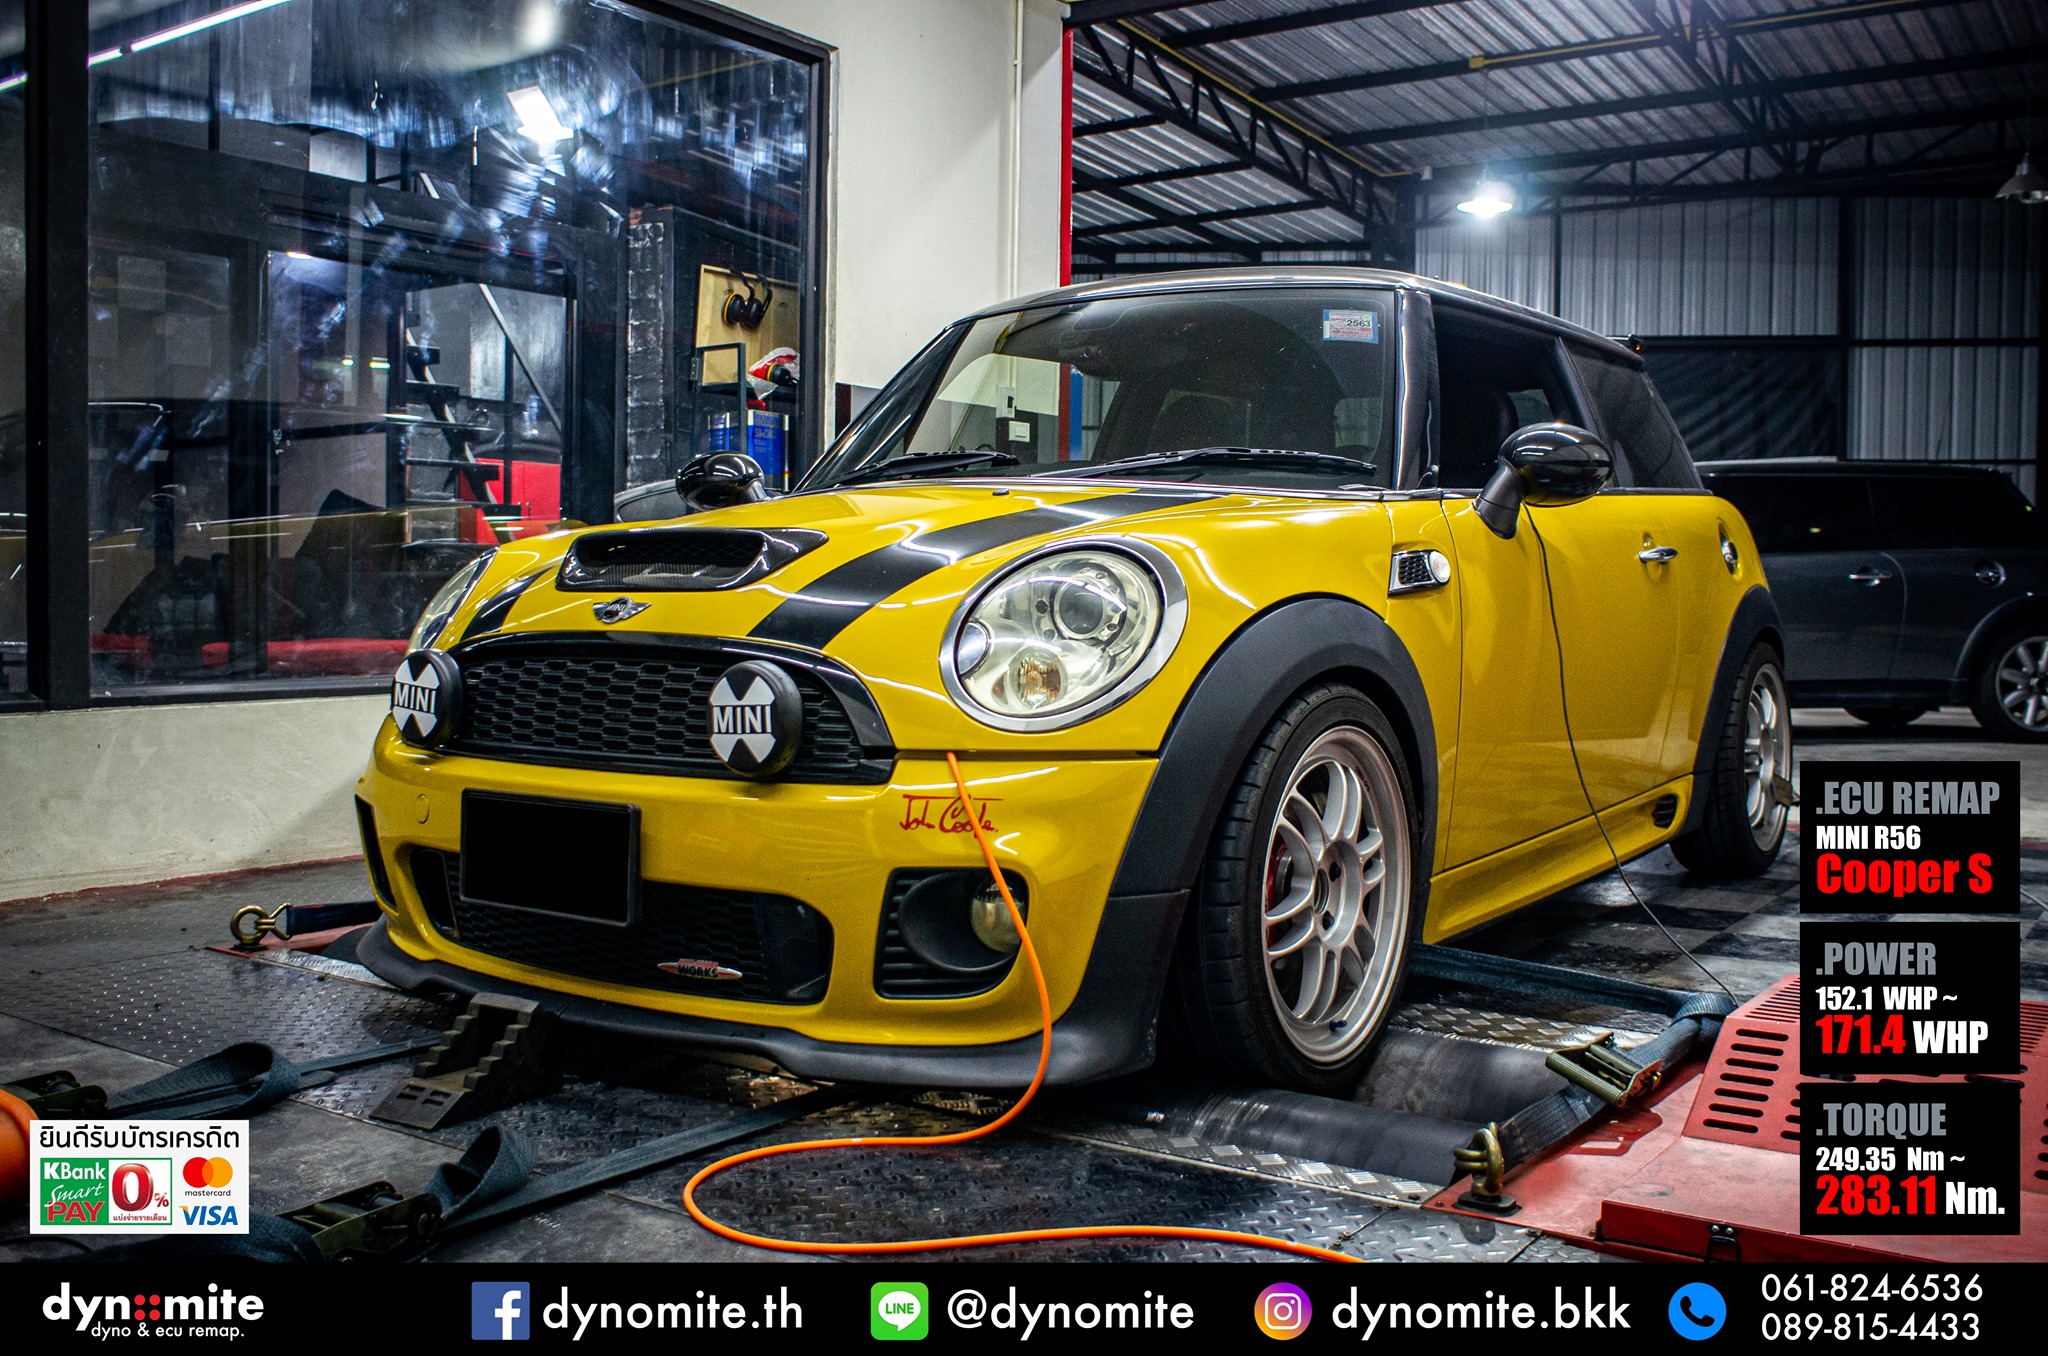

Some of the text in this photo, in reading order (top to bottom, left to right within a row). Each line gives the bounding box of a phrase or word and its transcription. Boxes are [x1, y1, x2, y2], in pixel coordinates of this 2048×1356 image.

[1346, 319, 1371, 327] 2563
[605, 603, 627, 612] MINI
[394, 683, 437, 714] MINI
[713, 705, 772, 734] MINI
[679, 965, 719, 978] WORKS
